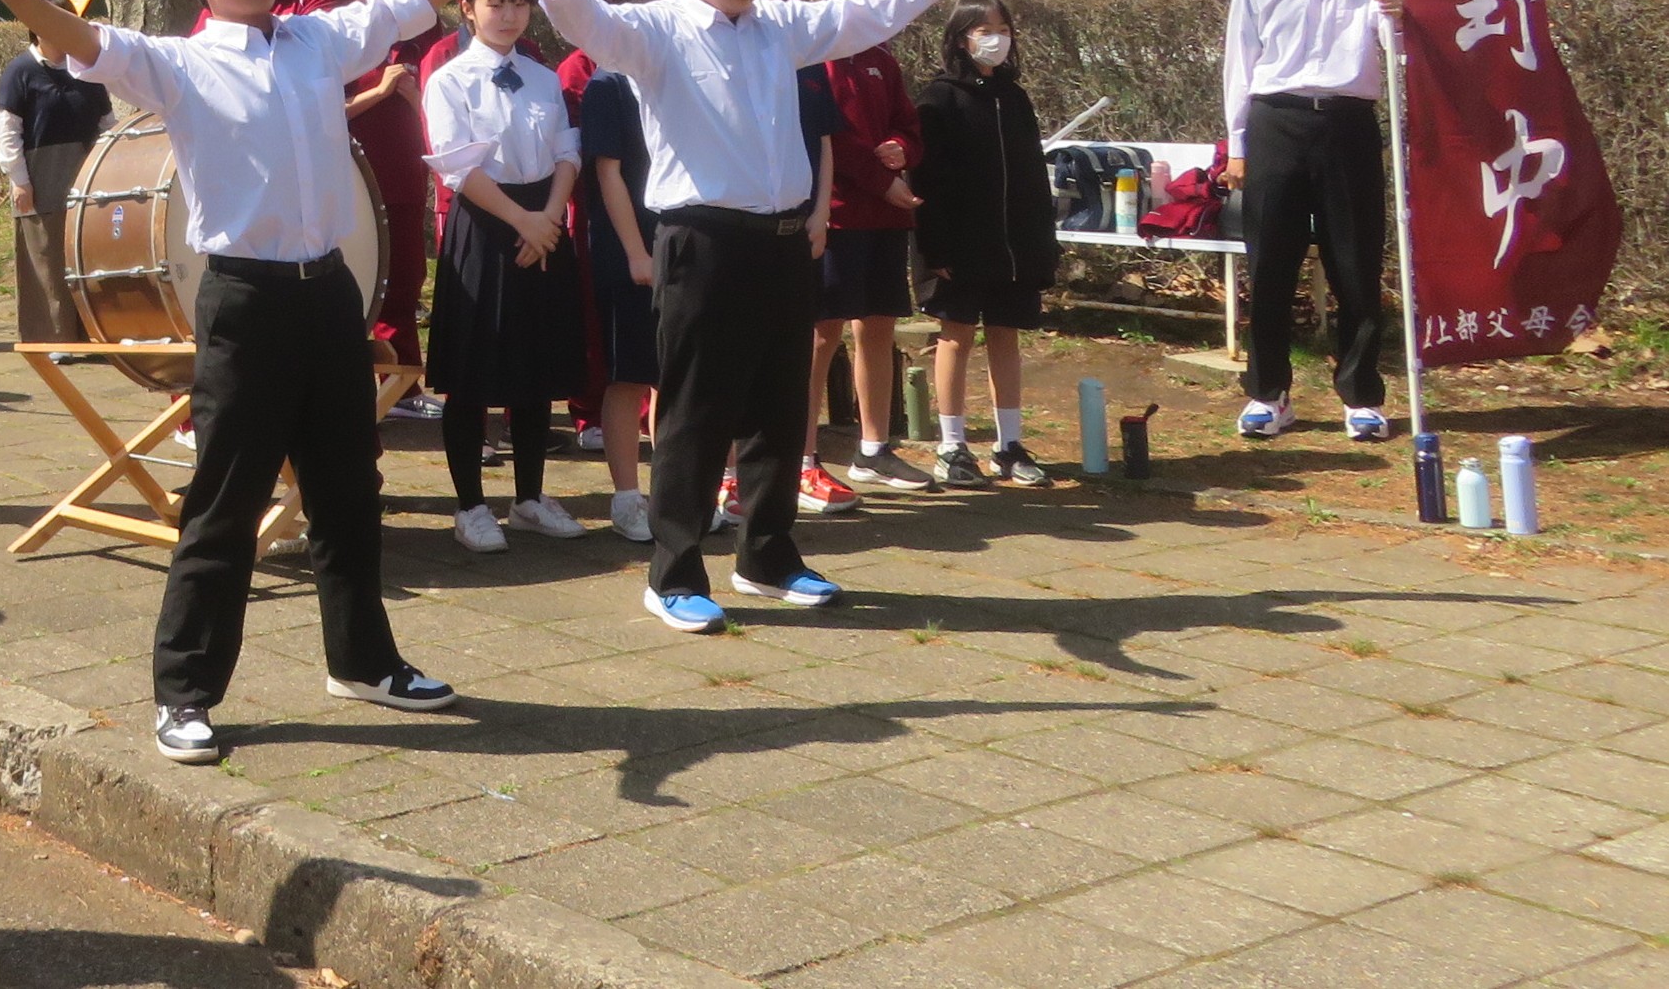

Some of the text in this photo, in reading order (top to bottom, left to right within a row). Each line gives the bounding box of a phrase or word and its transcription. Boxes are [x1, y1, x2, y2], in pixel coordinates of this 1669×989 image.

[1422, 303, 1594, 350] 上部父母会
